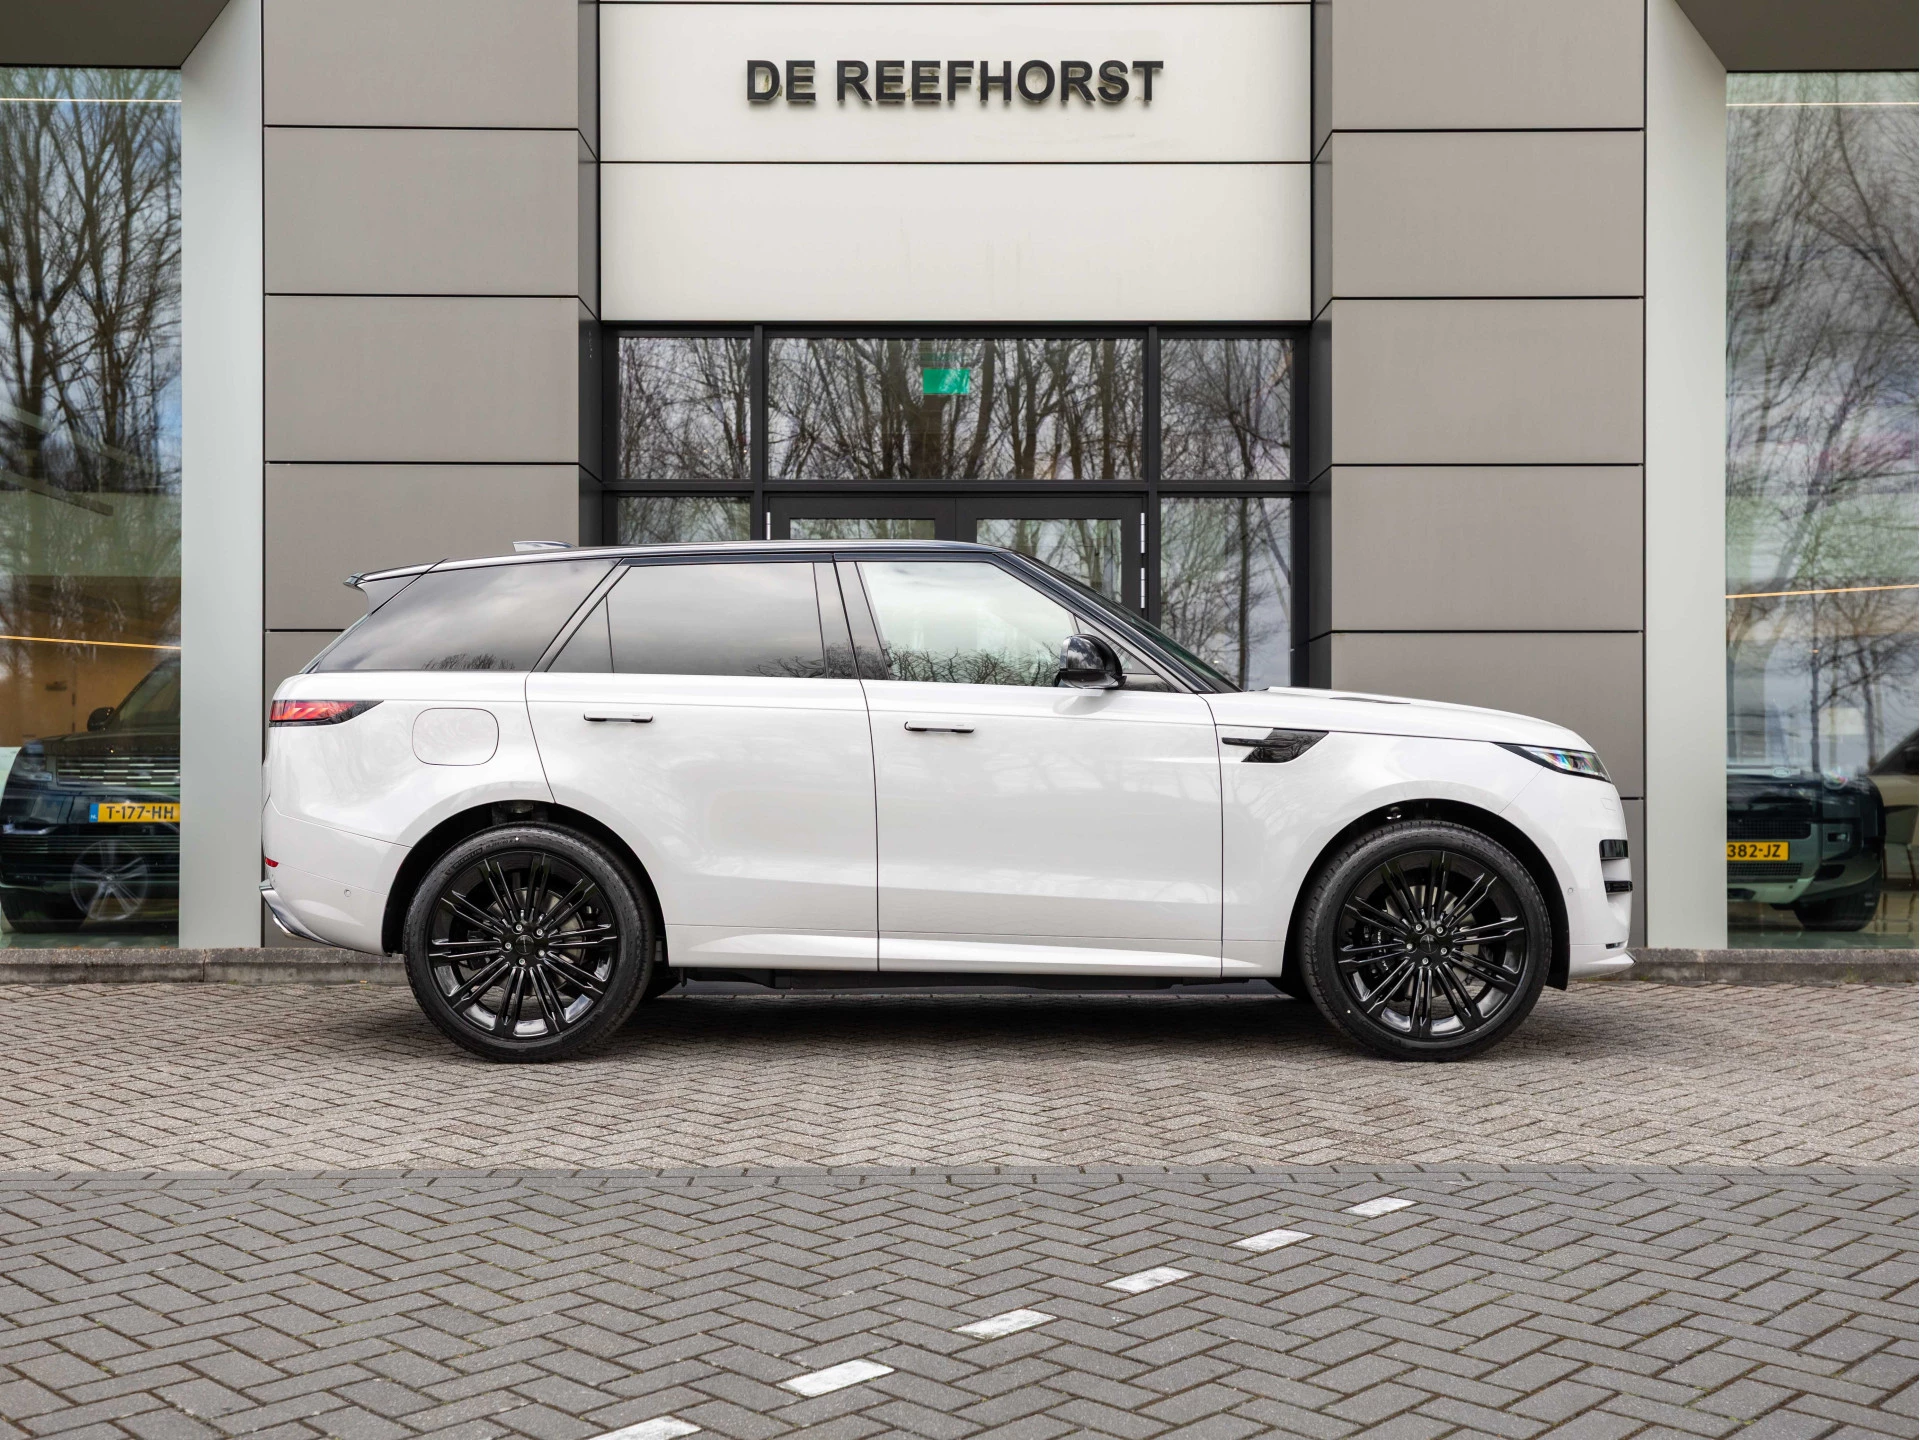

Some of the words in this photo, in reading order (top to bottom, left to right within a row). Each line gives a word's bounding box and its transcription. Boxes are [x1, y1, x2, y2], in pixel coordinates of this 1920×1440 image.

[747, 60, 816, 101] DE
[837, 60, 1164, 102] REEFHORST
[106, 805, 174, 819] T-177-HH
[1727, 844, 1781, 858] 382-JZ
